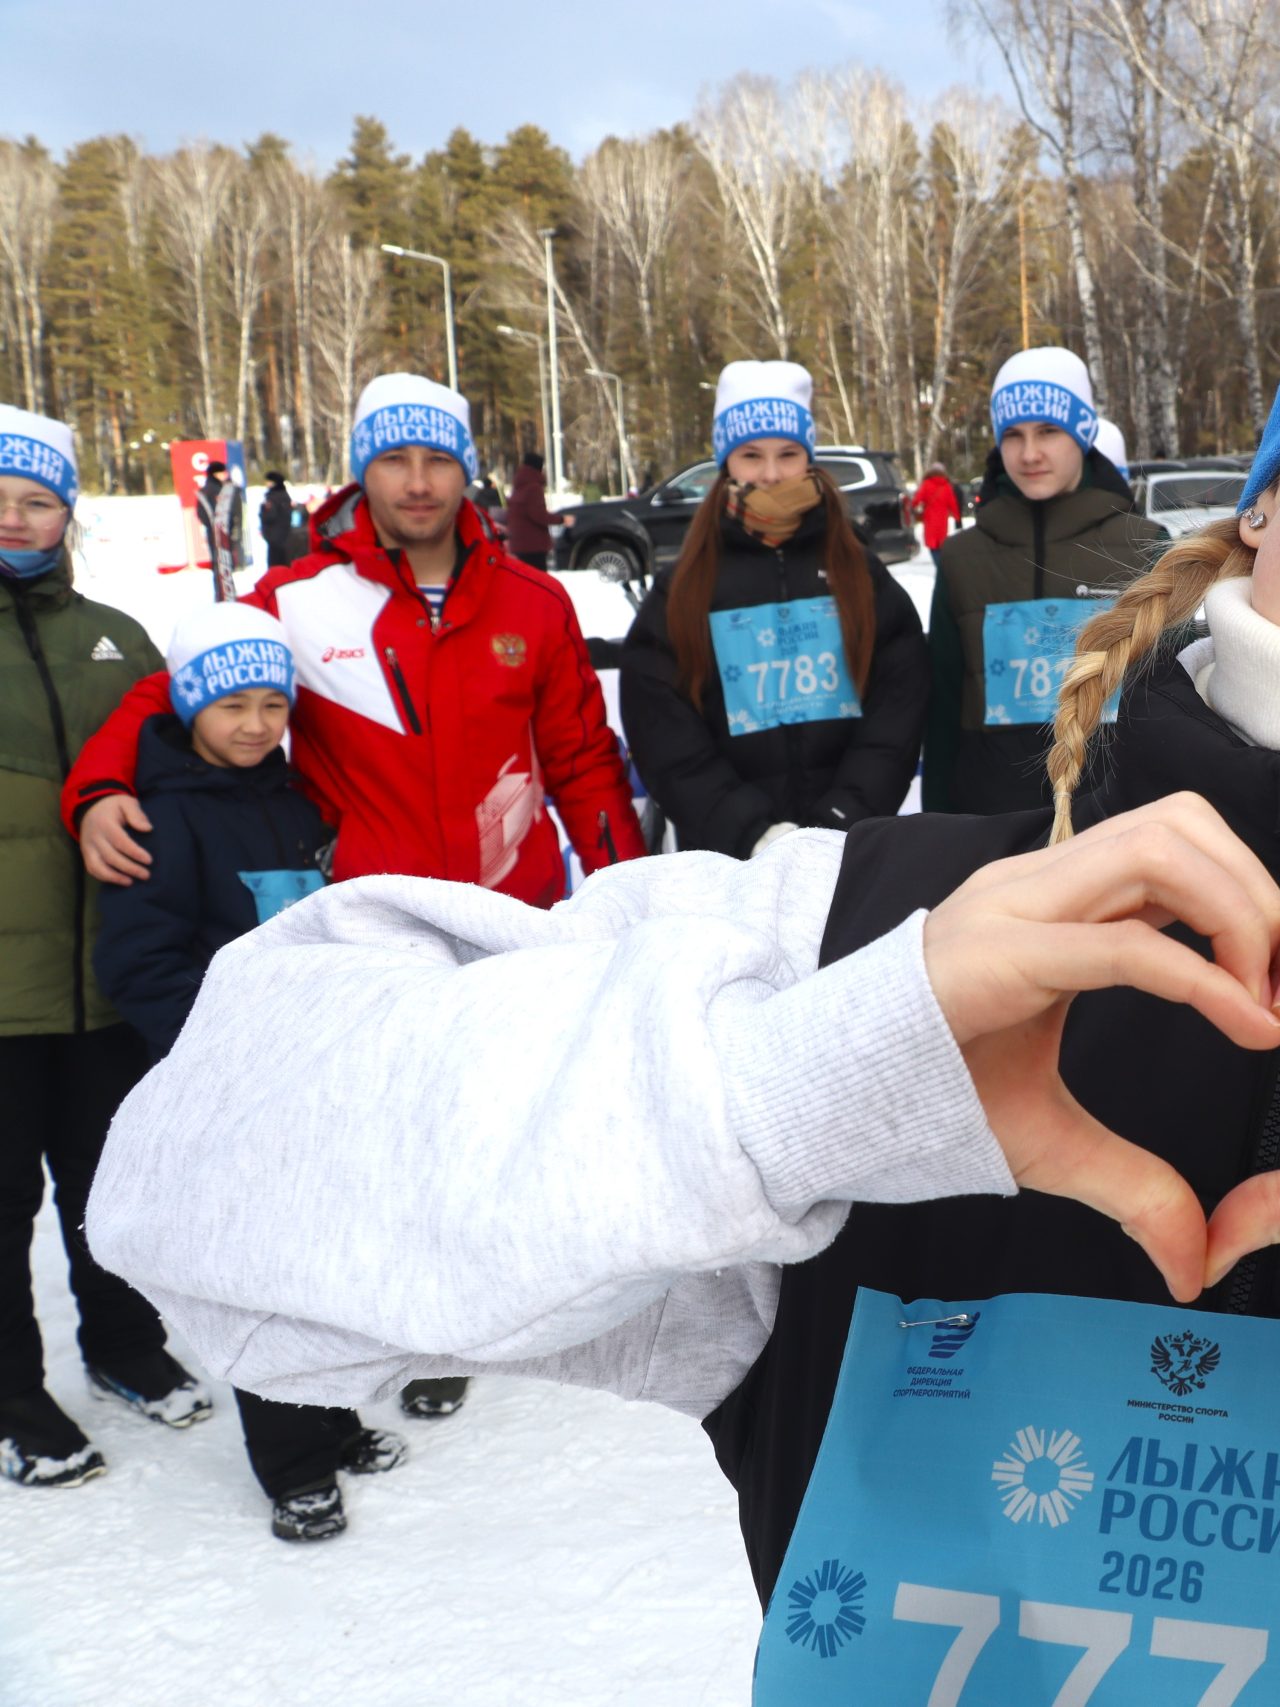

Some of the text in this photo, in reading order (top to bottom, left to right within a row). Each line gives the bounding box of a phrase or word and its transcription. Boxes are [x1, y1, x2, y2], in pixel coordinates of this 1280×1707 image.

[373, 406, 457, 431] ЛЫЖНЯ
[726, 401, 798, 427] ЛЫЖНЯ
[996, 400, 1070, 424] РОССИИ
[373, 424, 458, 450] РОССИИ
[727, 415, 799, 441] РОССИИ
[203, 642, 286, 677] ЛЫЖНЯ
[207, 662, 286, 694] РОССИИ
[747, 652, 839, 703] 7783
[906, 1366, 964, 1376] ФЕДЕРАЛЬНАЯ
[910, 1378, 953, 1387] ДИРЕКЦИЯ
[893, 1388, 971, 1399] СПОРТМЕРОПРИЯТИЙ
[1127, 1399, 1229, 1418] МИНИСТЕРСТВО СПОРТА
[1158, 1413, 1194, 1424] РОССИИ
[1098, 1550, 1205, 1604] 2026
